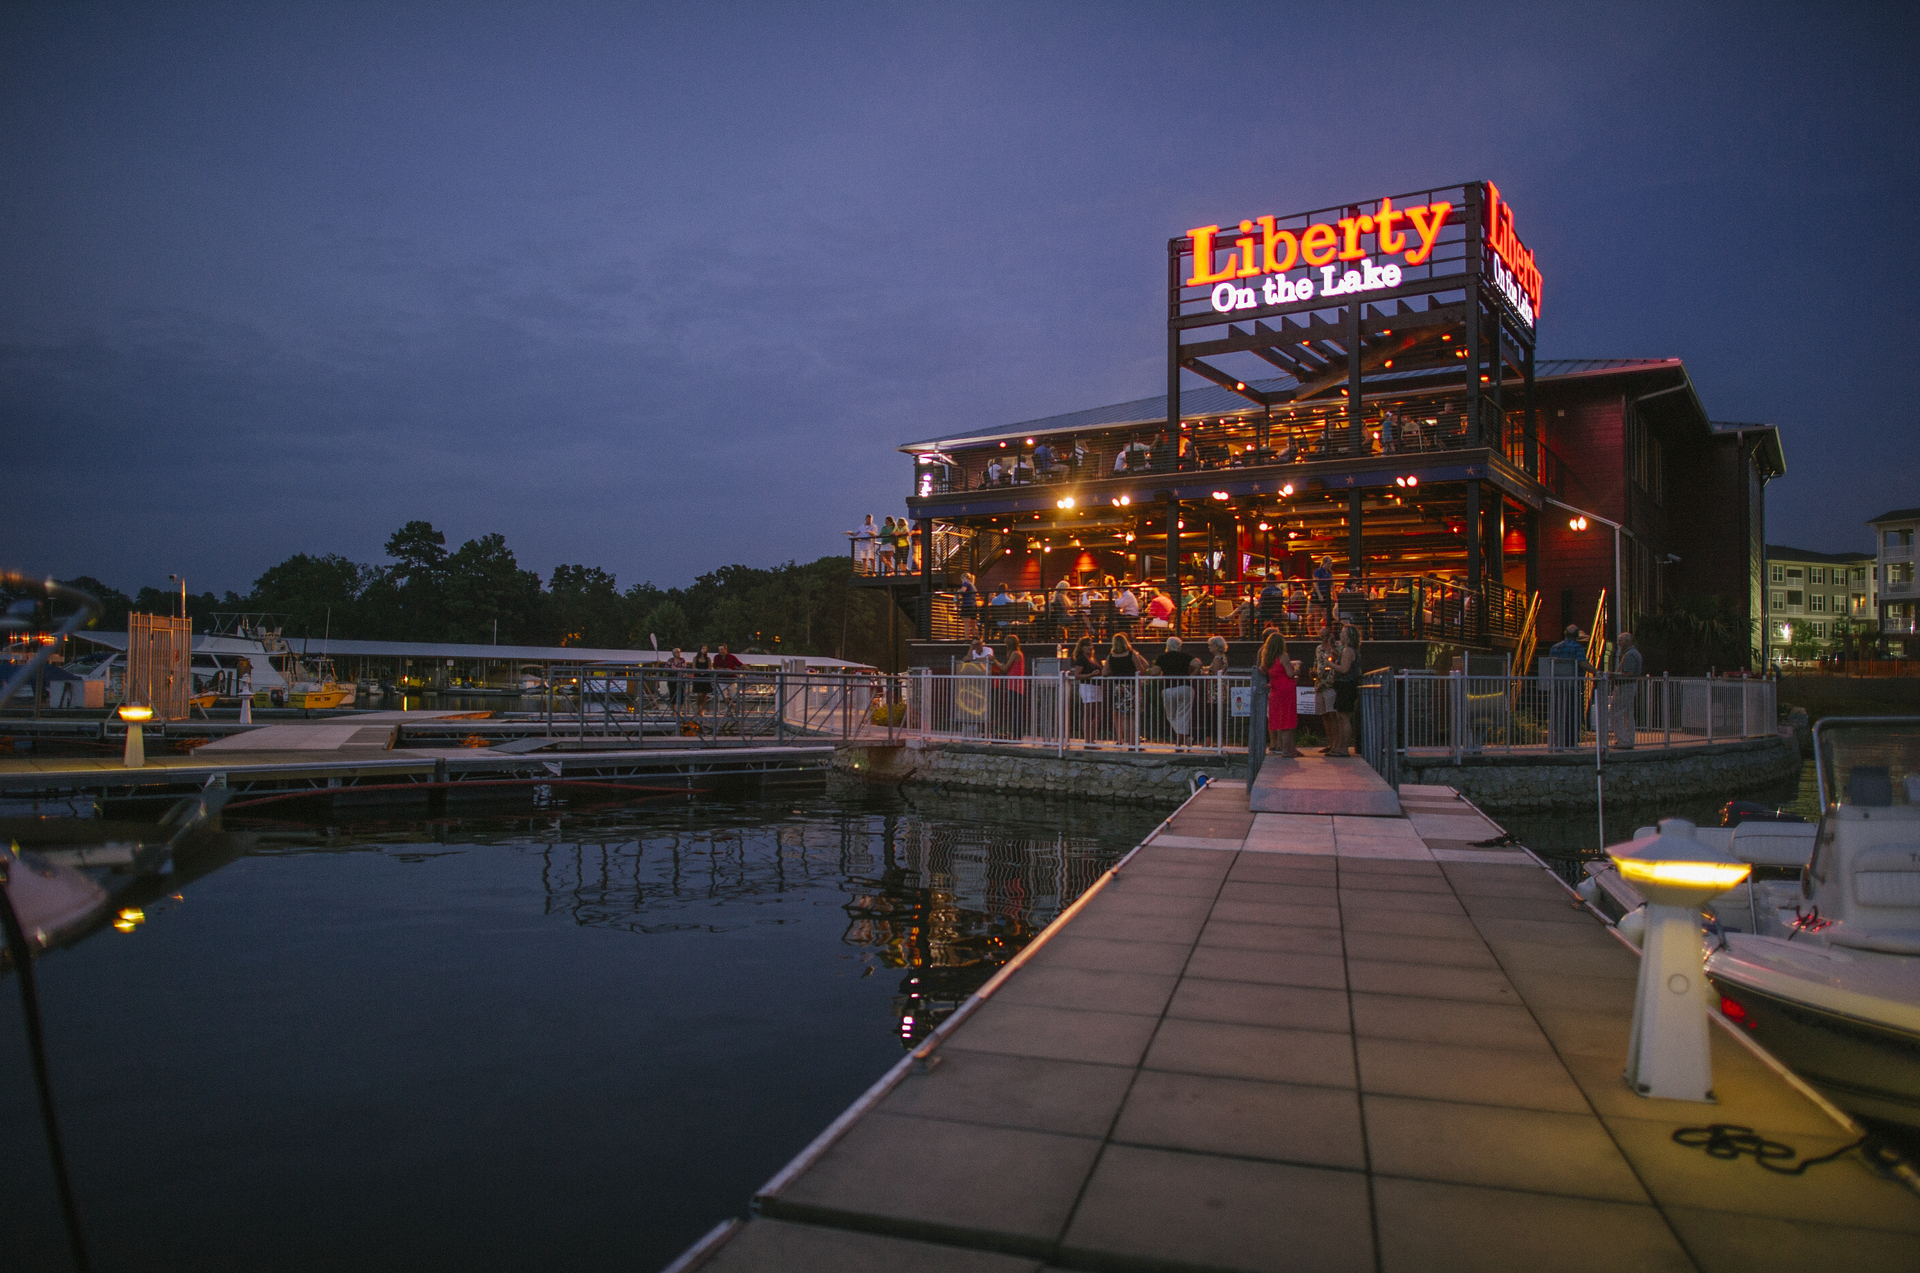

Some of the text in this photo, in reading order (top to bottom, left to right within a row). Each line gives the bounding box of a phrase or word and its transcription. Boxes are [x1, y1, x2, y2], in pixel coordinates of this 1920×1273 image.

[1186, 197, 1452, 286] Liberty
[1211, 258, 1402, 312] On the Lake
[1487, 180, 1543, 319] Liberty
